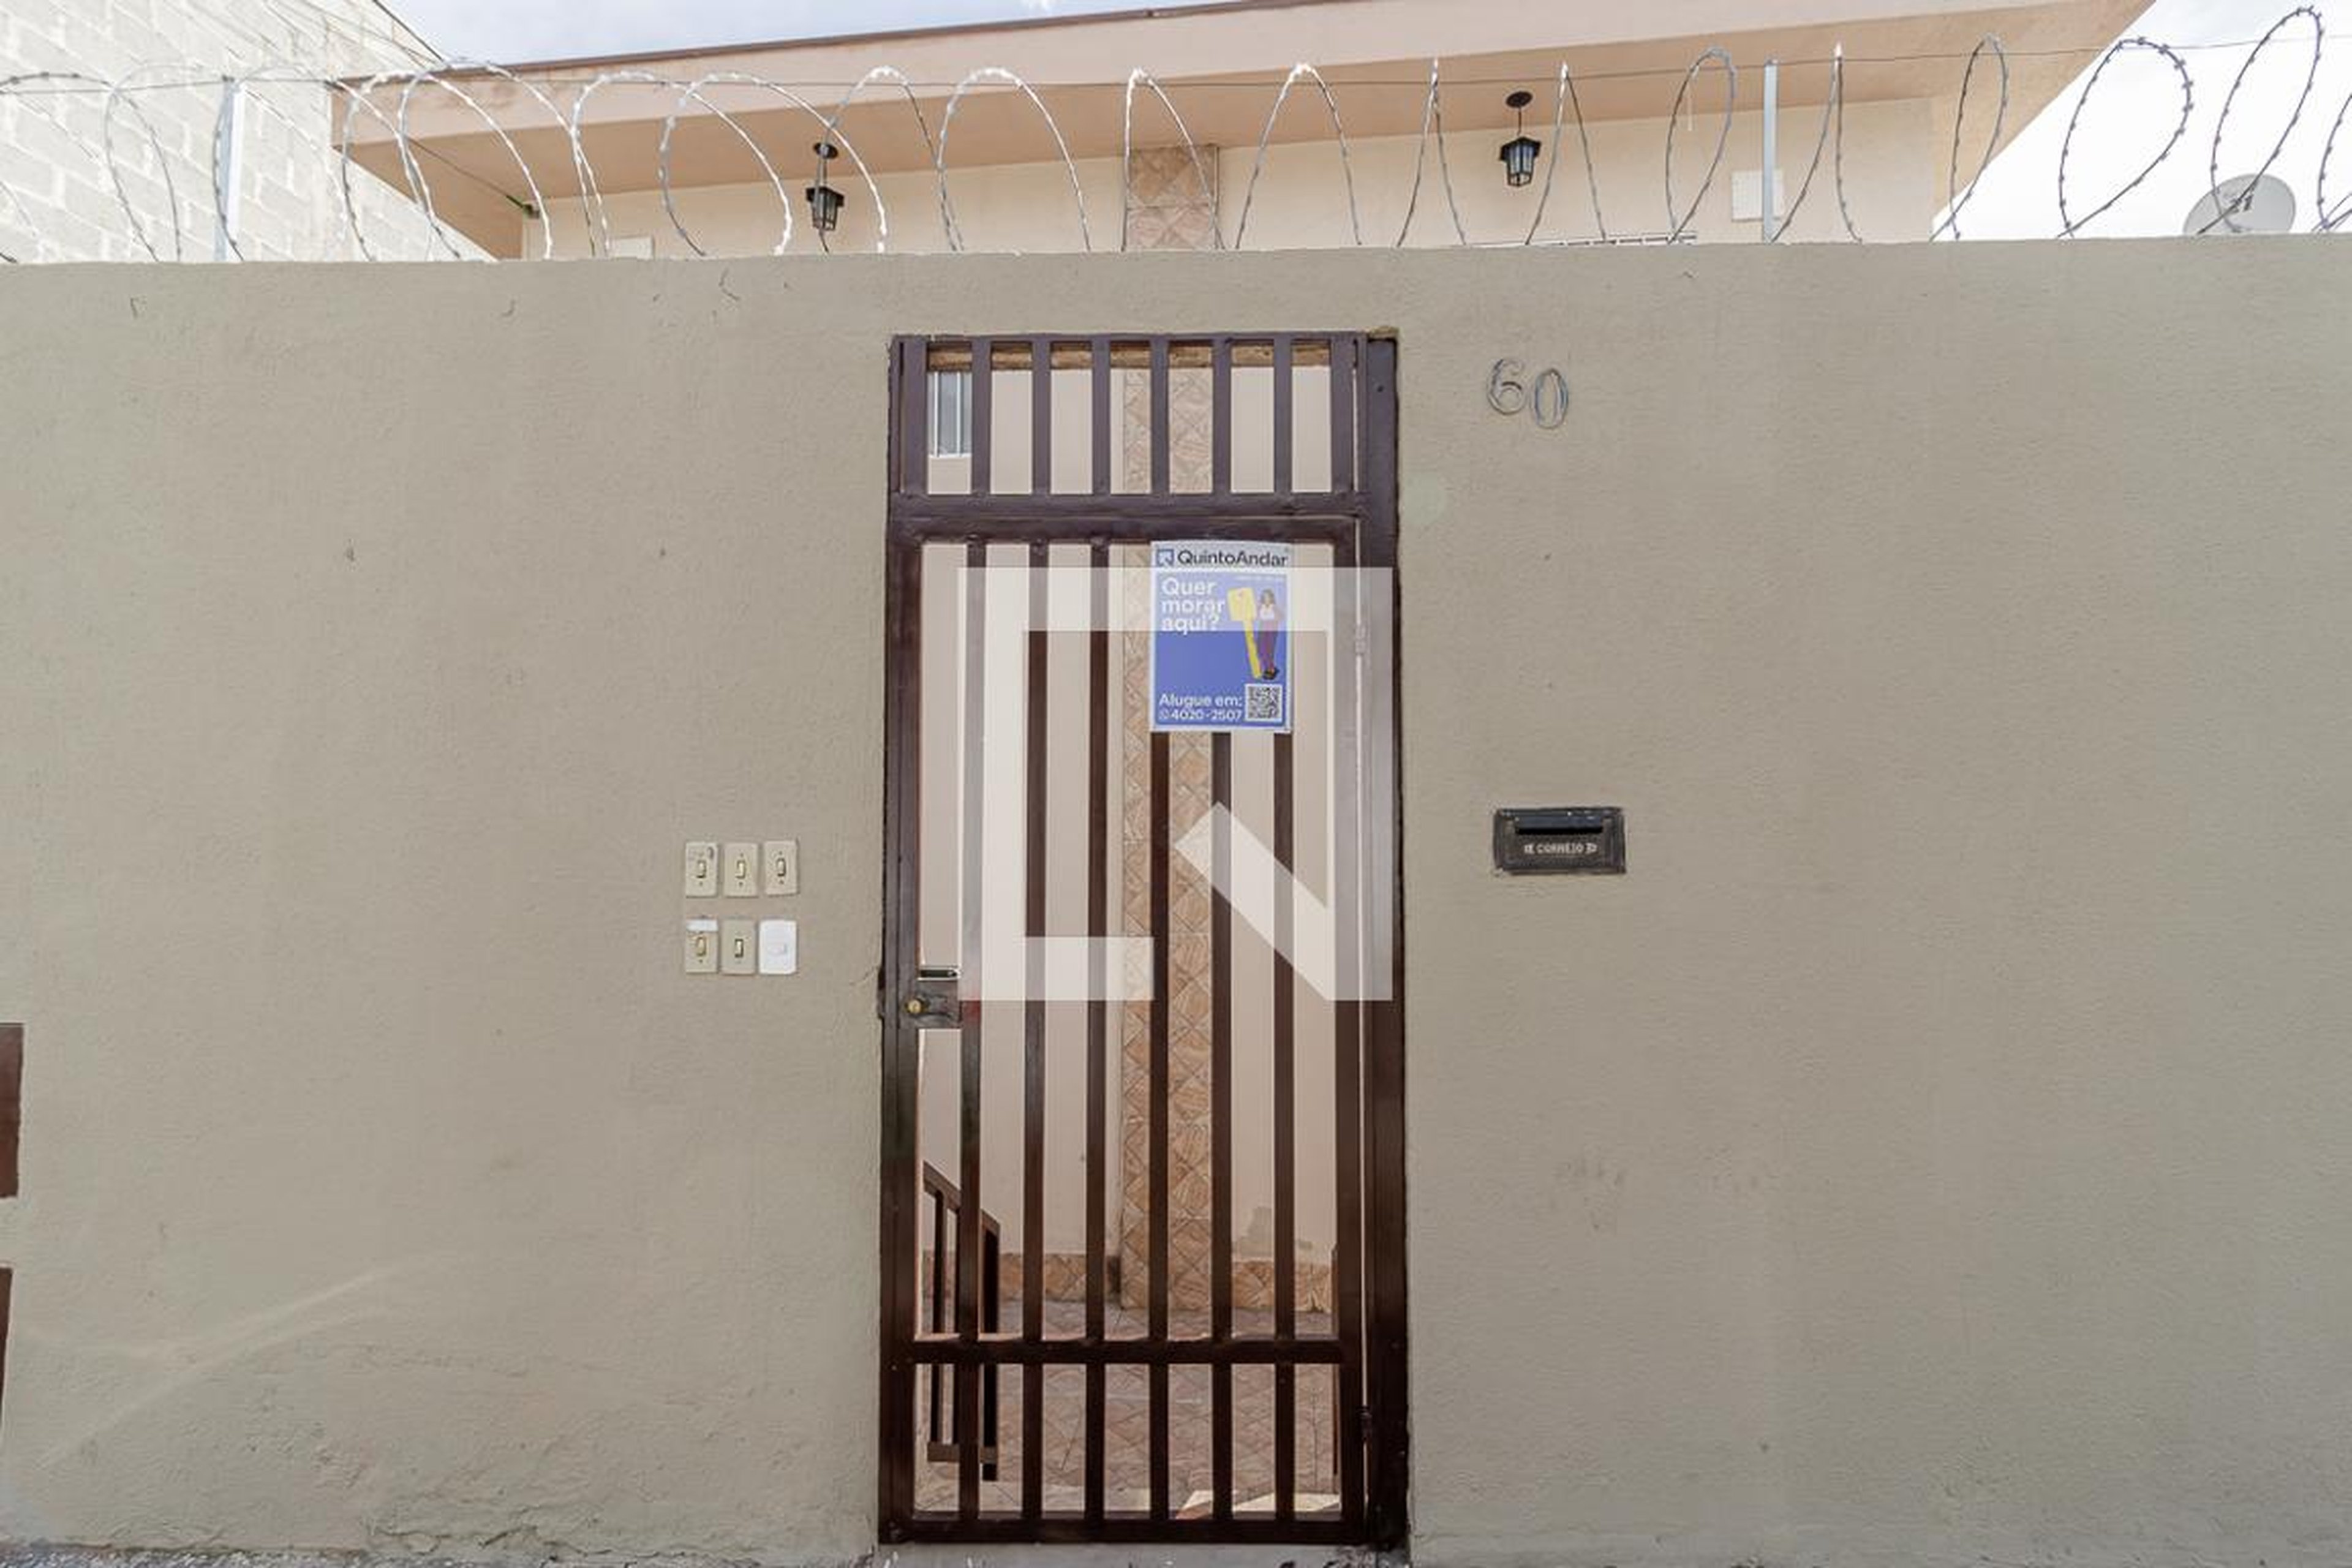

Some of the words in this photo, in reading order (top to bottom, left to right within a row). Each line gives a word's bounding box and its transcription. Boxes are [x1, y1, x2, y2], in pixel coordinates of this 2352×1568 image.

[1487, 358, 1569, 429] 60
[1177, 550, 1287, 567] QuintoAndar
[1163, 578, 1217, 596] Quer
[1163, 598, 1224, 613] morar
[1163, 614, 1219, 635] aqui?
[1159, 693, 1212, 708] Alugue
[1215, 696, 1242, 707] em:
